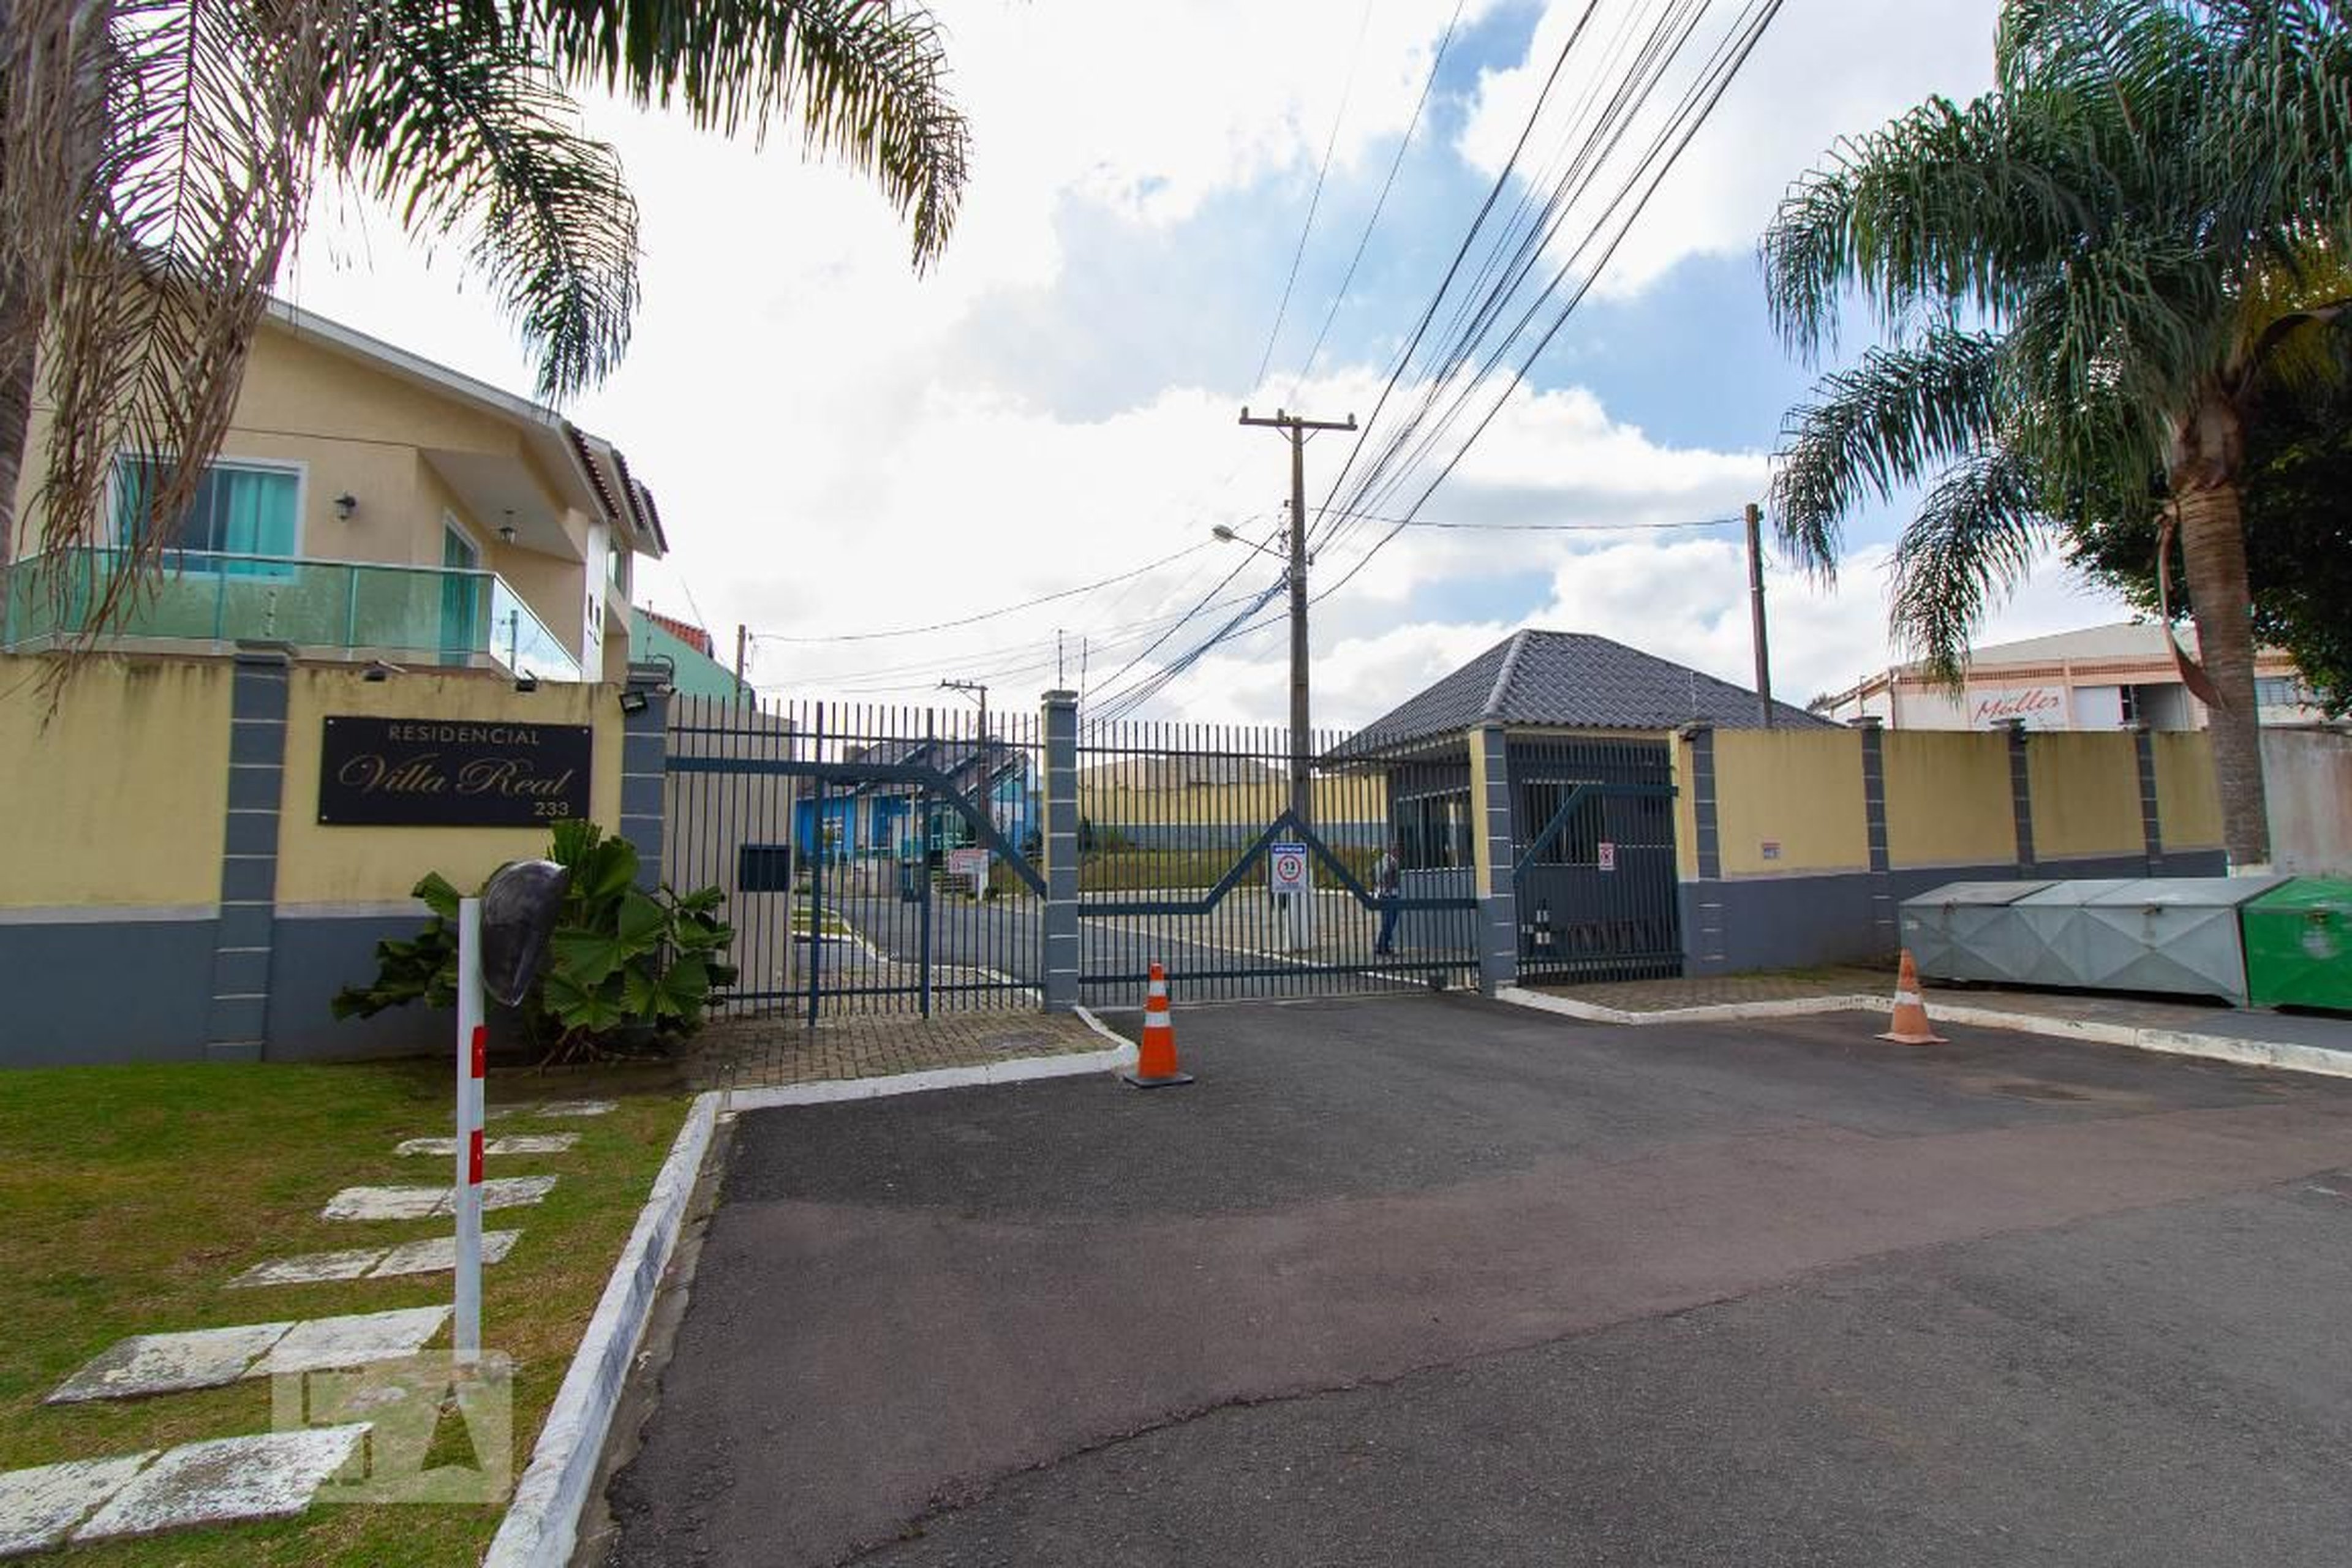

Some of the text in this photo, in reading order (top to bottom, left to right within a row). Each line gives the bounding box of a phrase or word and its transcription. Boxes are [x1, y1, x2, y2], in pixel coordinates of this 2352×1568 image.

[388, 725, 540, 745] RESIDENCIAL
[339, 753, 573, 796] Villa Real
[533, 801, 570, 816] 233
